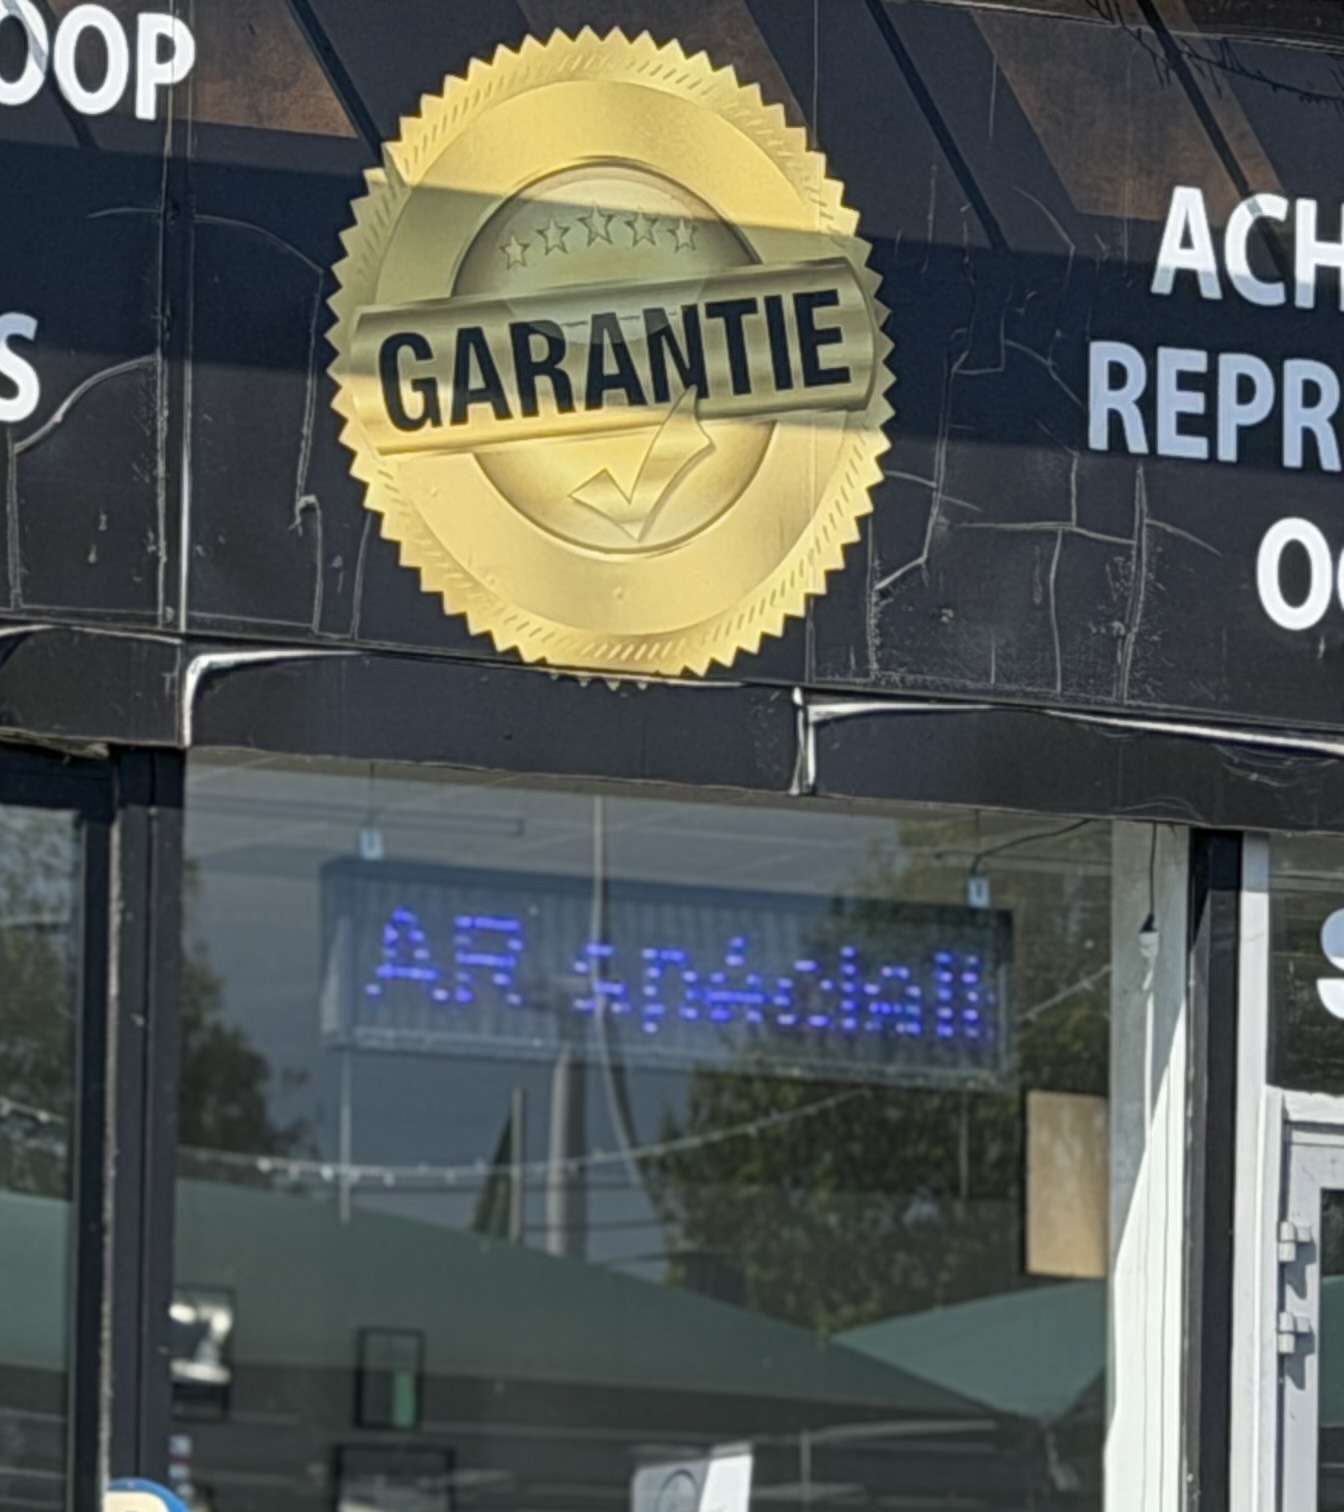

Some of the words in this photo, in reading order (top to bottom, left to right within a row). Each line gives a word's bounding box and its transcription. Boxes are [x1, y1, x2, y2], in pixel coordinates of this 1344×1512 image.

[1150, 186, 1344, 312] ACH
[378, 289, 852, 432] GARANTIE
[1088, 340, 1343, 472] REPR
[1257, 517, 1344, 631] O
